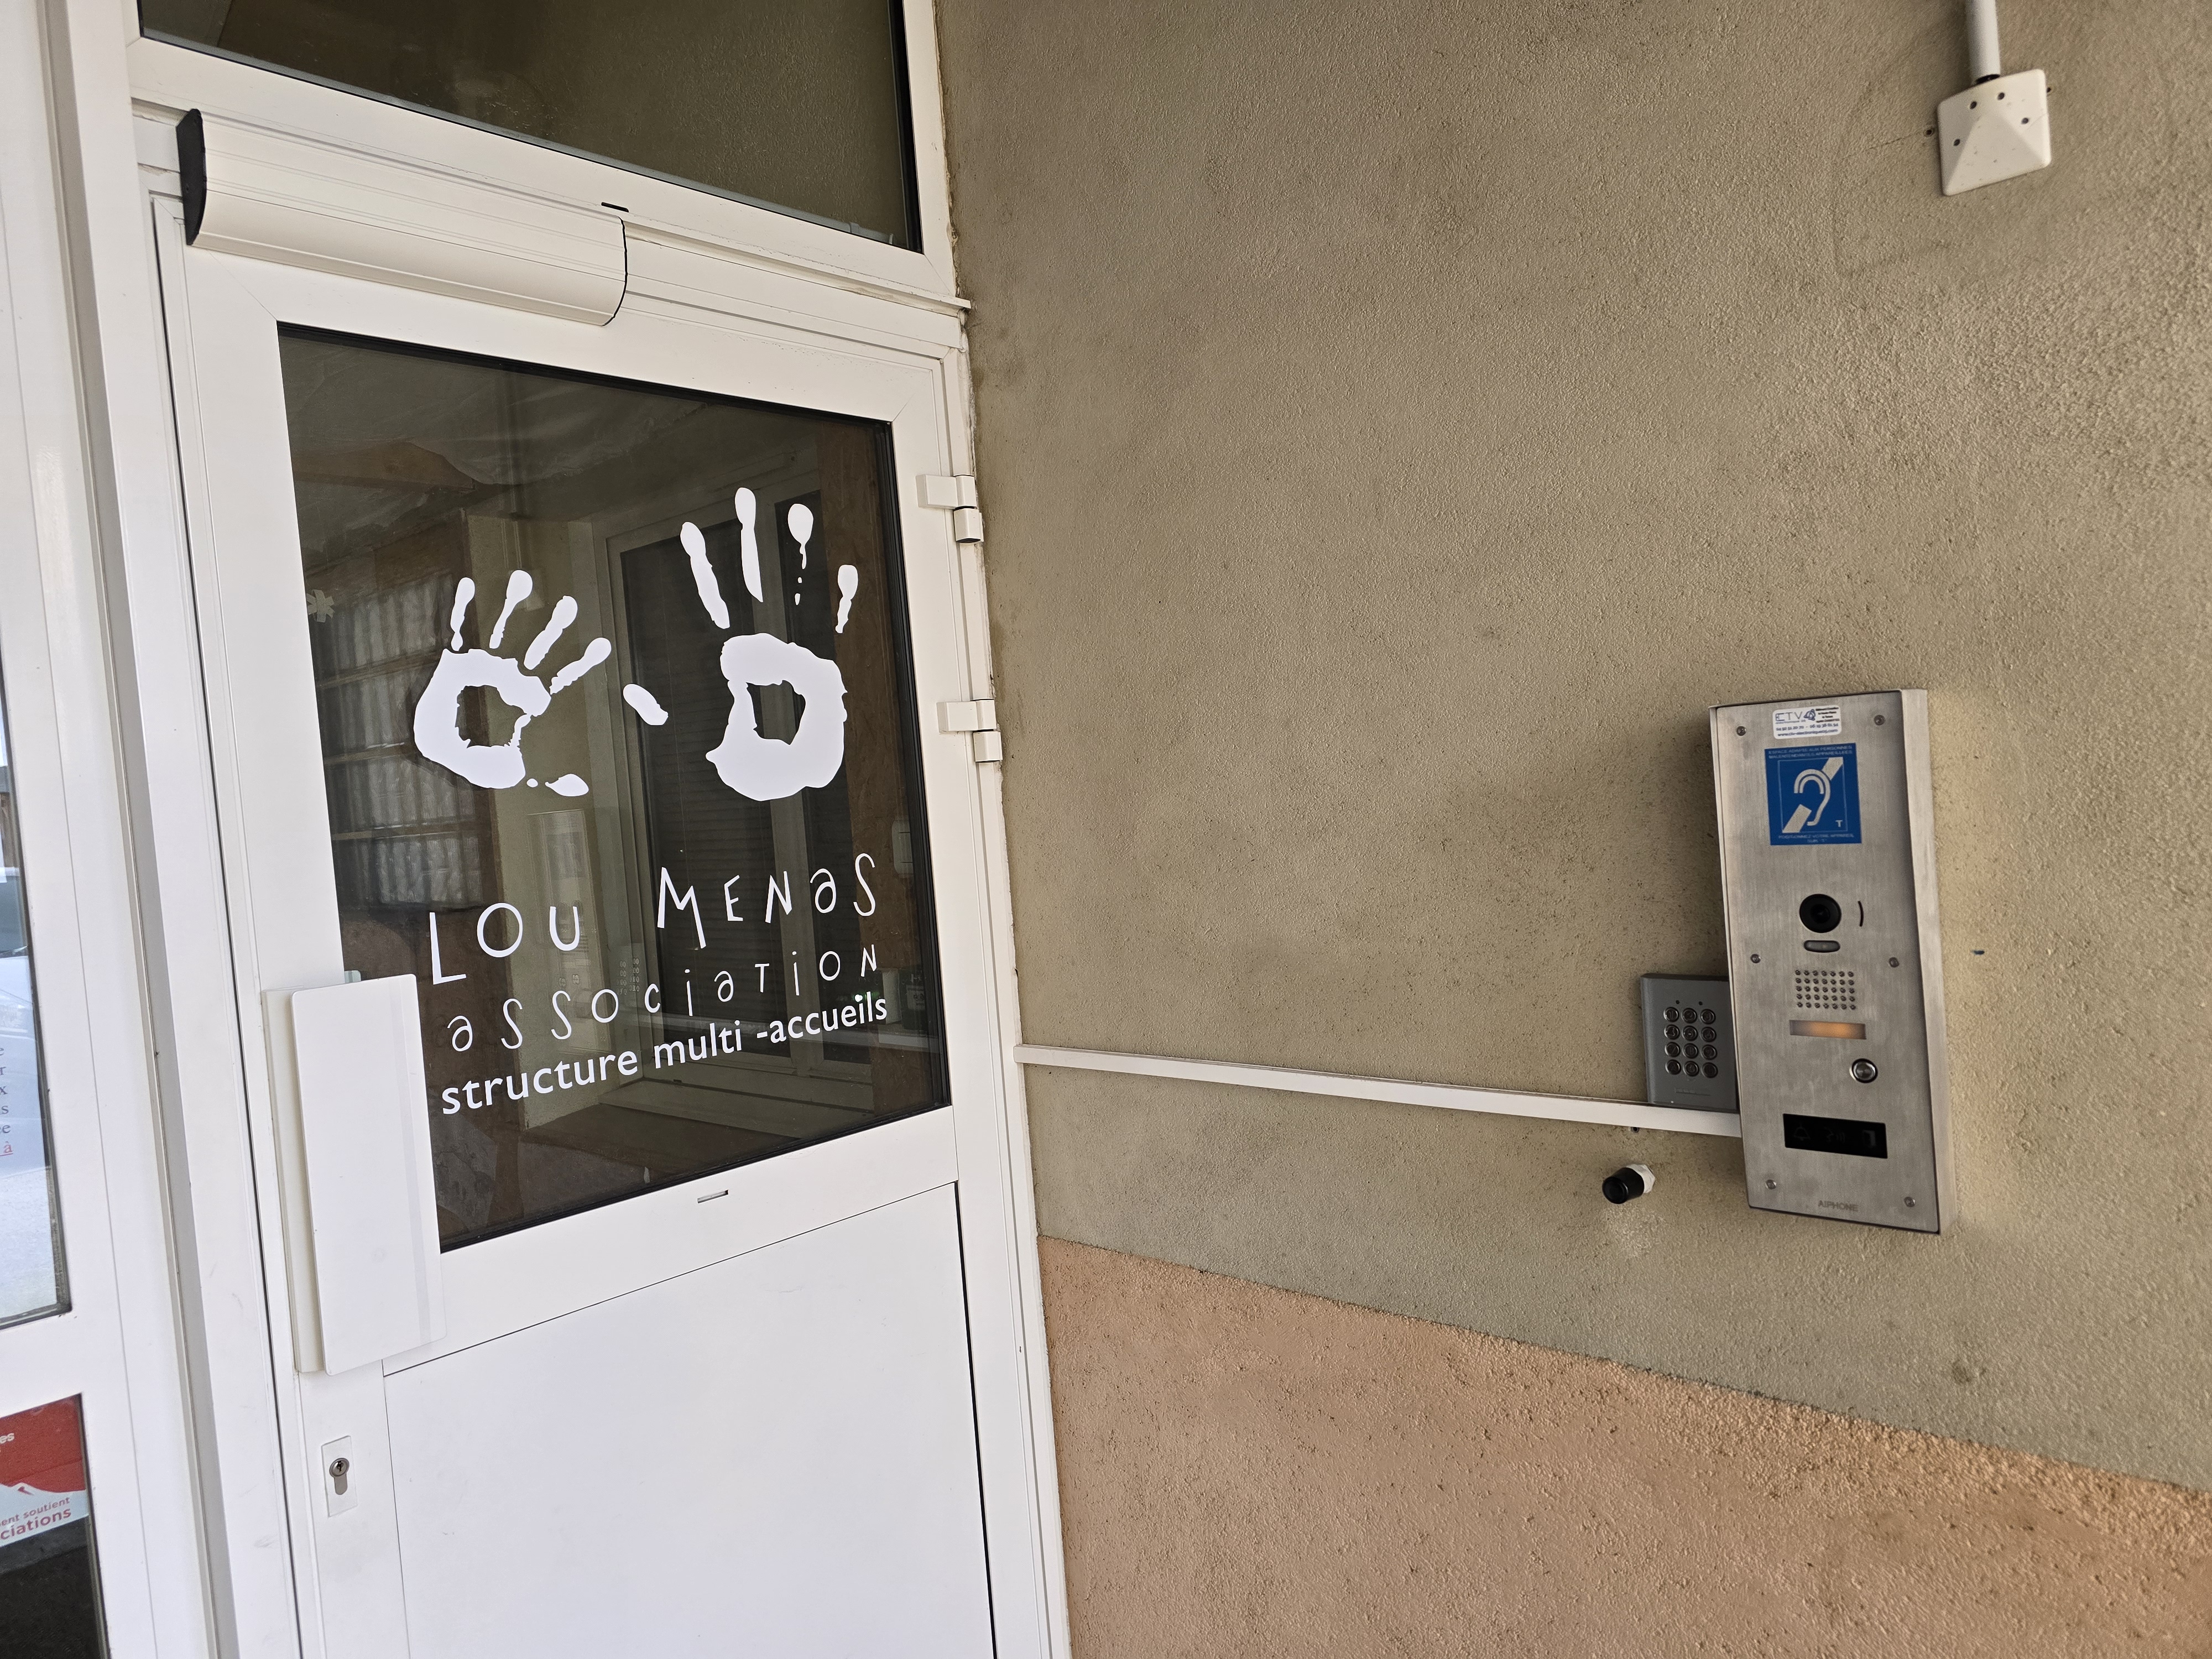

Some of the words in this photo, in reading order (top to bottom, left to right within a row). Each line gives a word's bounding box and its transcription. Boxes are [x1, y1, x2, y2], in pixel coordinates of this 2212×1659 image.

[429, 902, 580, 984] LOU
[442, 1050, 638, 1115] structure
[654, 1021, 742, 1069] multi
[756, 991, 888, 1044] -accueils
[1817, 1199, 1859, 1212] AIPHONE
[23, 1496, 70, 1519] soutient
